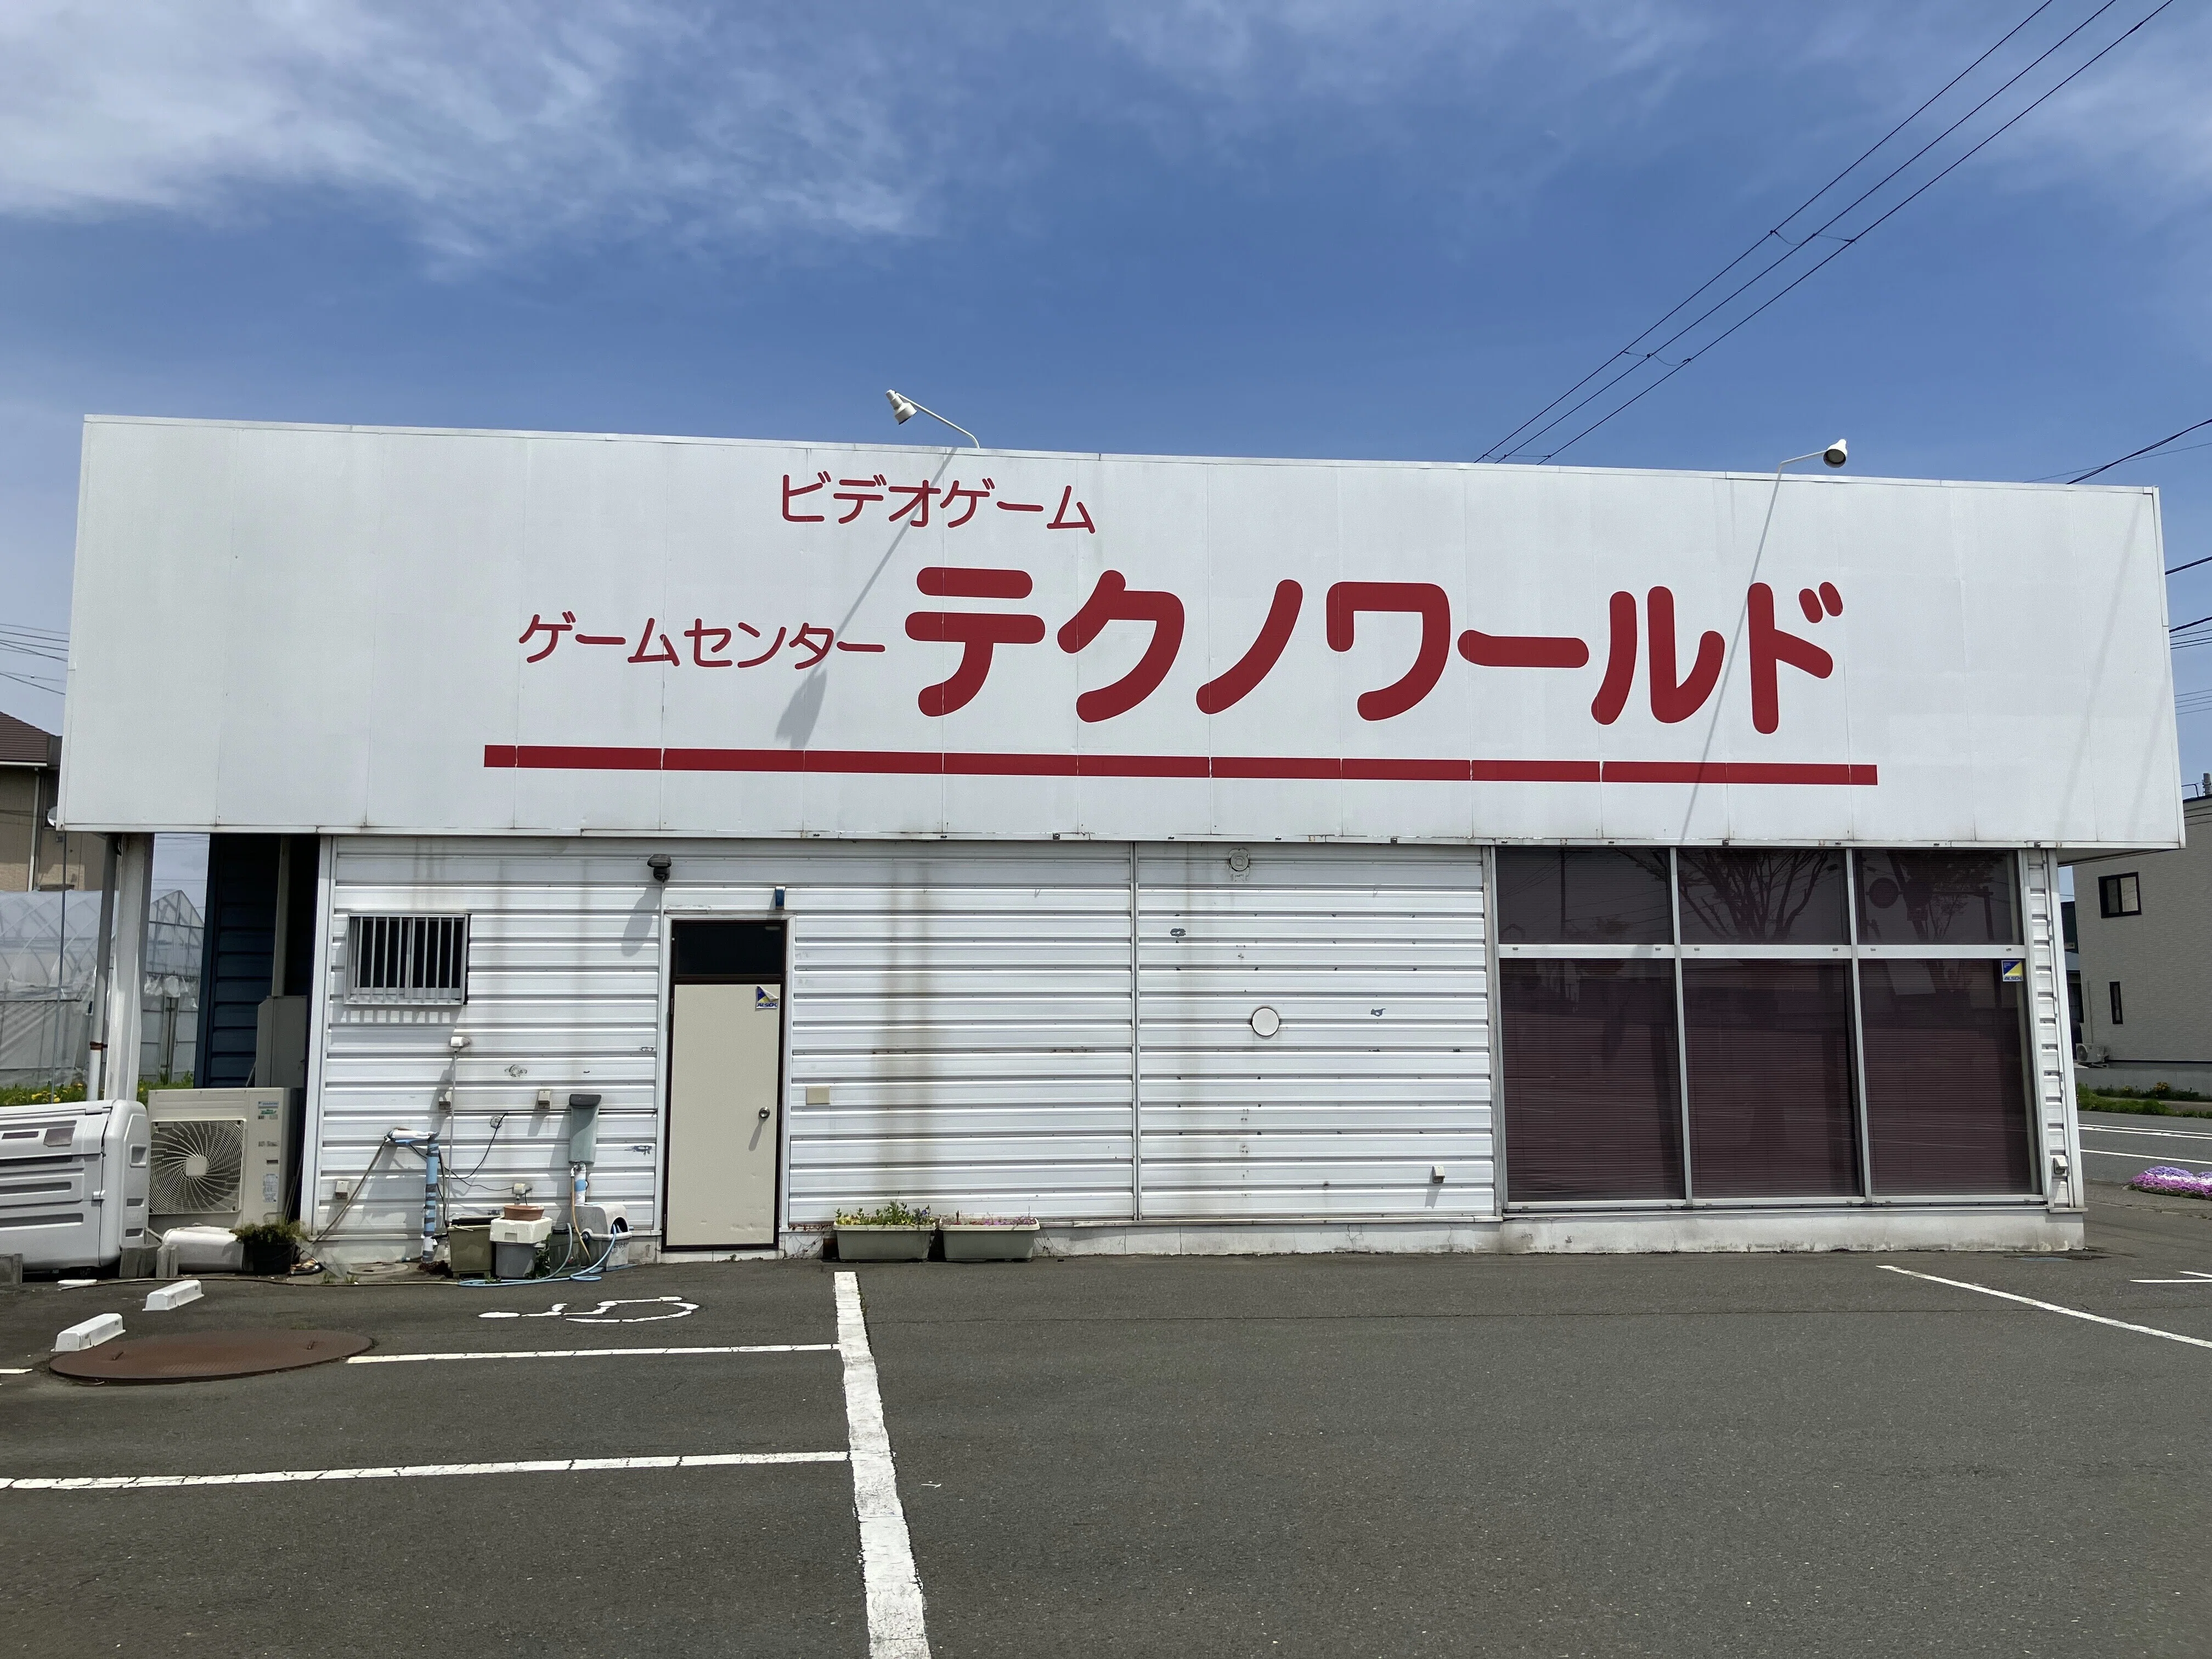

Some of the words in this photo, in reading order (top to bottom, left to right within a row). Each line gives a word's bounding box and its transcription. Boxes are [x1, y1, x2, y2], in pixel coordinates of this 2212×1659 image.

[783, 476, 1095, 533] ビデオゲーム
[519, 612, 885, 669] ゲームセンター
[905, 567, 1843, 734] テクノワールド
